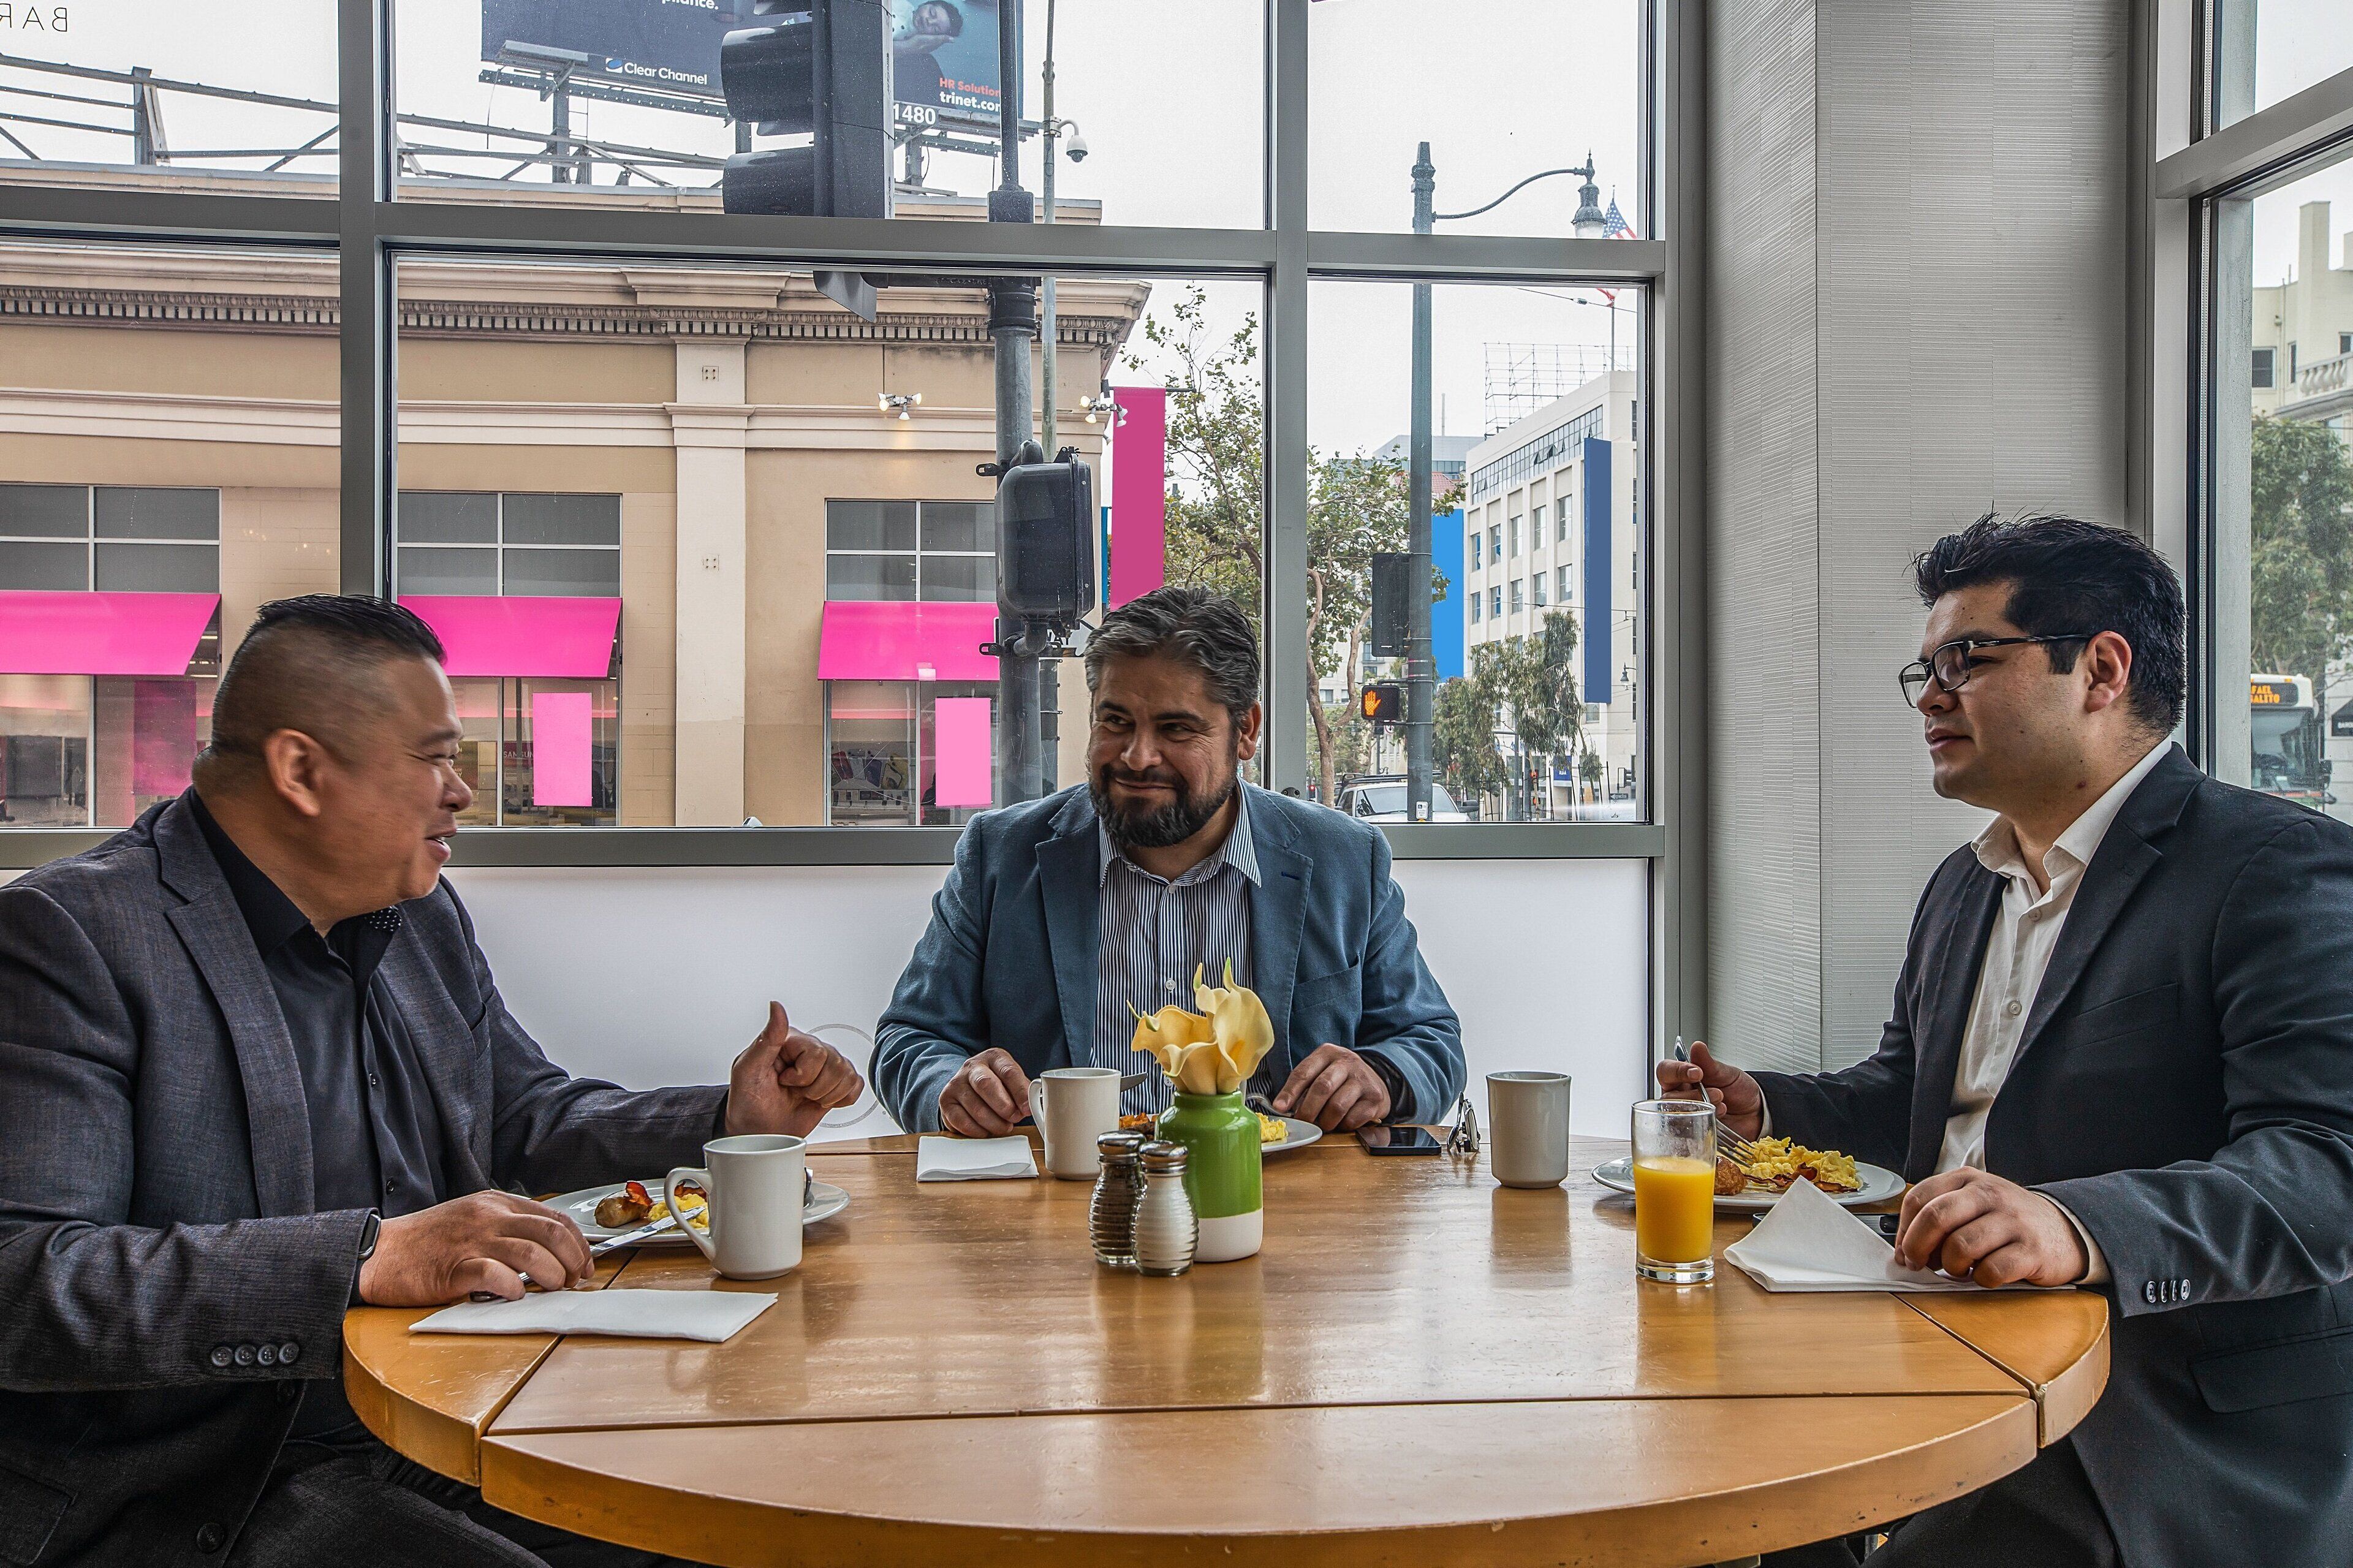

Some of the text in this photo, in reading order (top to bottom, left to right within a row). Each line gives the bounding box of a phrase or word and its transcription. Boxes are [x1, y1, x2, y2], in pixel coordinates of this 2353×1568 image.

[624, 62, 708, 85] Clear Channel
[939, 78, 955, 89] HR
[893, 104, 936, 125] 1480
